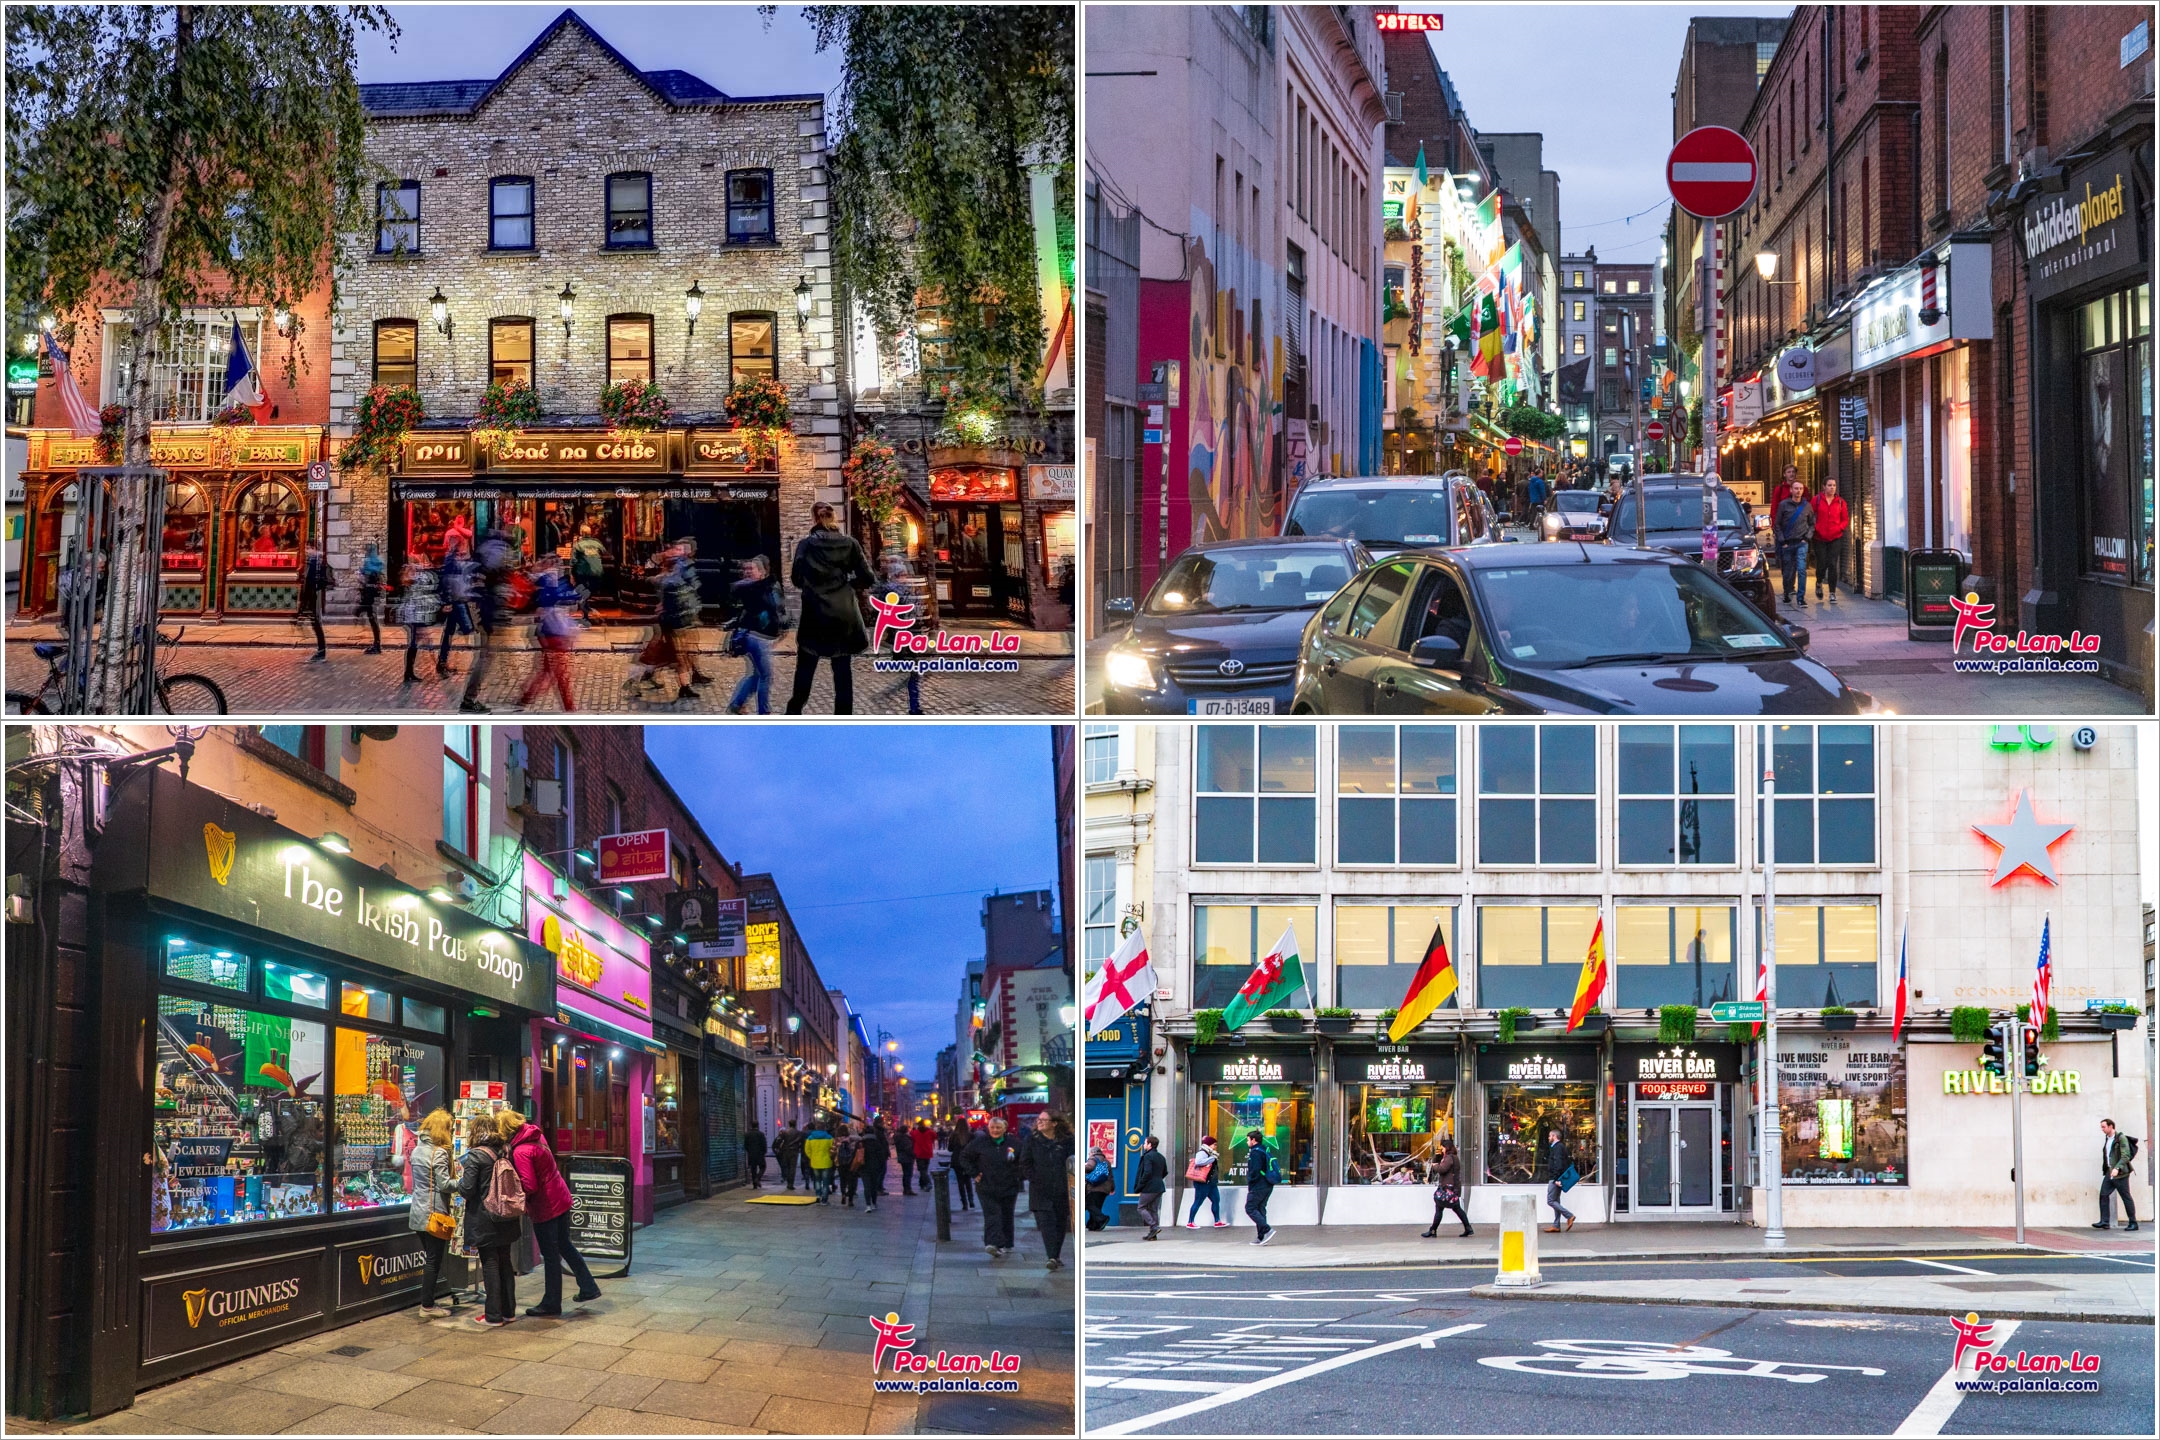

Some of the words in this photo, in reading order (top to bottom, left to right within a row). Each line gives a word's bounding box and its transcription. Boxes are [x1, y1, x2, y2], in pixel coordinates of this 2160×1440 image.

[2040, 228, 2117, 279] international
[1840, 397, 1854, 440] COFFEE
[249, 446, 287, 461] BAR
[559, 448, 588, 459] na
[1049, 468, 1075, 480] QUAY
[473, 490, 499, 498] MUSIC
[2094, 536, 2126, 558] HALLOW
[1206, 702, 1270, 715] 07-D-13489
[616, 833, 650, 847] OPEN
[621, 848, 663, 866] sitar
[603, 870, 630, 878] Indian
[632, 866, 664, 875] Cuisine
[284, 857, 343, 917] The
[357, 886, 419, 946] Irish
[477, 939, 523, 989] Shop
[746, 922, 779, 936] RORY'S
[275, 1023, 306, 1042] SHOP
[1097, 1030, 1120, 1041] FOOD
[404, 1043, 425, 1060] SHOP
[1777, 1053, 1795, 1062] LIVE
[1797, 1053, 1828, 1062] MUSIC
[1848, 1053, 1868, 1062] LATE
[1870, 1053, 1889, 1062] BAR
[1223, 1064, 1257, 1076] RIVER
[1259, 1064, 1282, 1075] BAR
[1367, 1064, 1400, 1075] RIVER
[1402, 1064, 1424, 1075] BAR
[1509, 1064, 1541, 1075] RIVER
[1544, 1064, 1566, 1075] BAR
[1639, 1059, 1682, 1073] RIVER
[1685, 1059, 1715, 1073] BAR
[1778, 1073, 1798, 1081] FOOD
[1799, 1073, 1828, 1081] SERVED
[1845, 1073, 1861, 1081] LIVE
[1862, 1073, 1893, 1081] SPORTS
[2031, 1070, 2081, 1094] BAR
[176, 1083, 234, 1096] SOUVENIRS
[1642, 1084, 1667, 1093] FOOD
[1670, 1084, 1706, 1093] SERVED
[1658, 1092, 1672, 1100] All
[1673, 1092, 1689, 1101] Day
[175, 1100, 233, 1115] GIFTWARE
[175, 1119, 232, 1136] KNITWEAR
[174, 1142, 221, 1156] SCARVES
[173, 1162, 233, 1178] JEWELLERY
[1229, 1168, 1237, 1176] AT
[173, 1184, 218, 1198] THROWS
[381, 1277, 398, 1285] OFFICIAL
[208, 1278, 300, 1317] GUINNESS
[218, 1314, 247, 1327] OFFICIAL
[248, 1303, 289, 1320] MERCHANDISE
